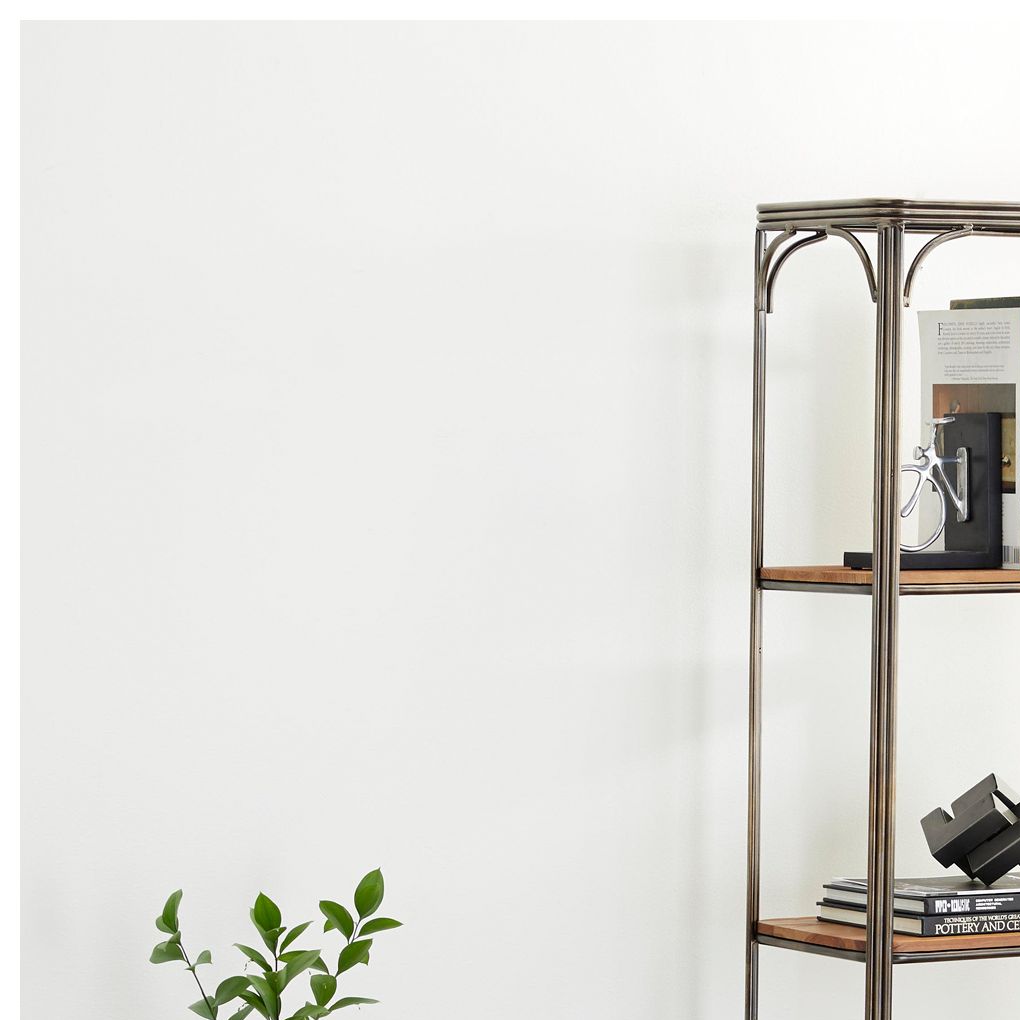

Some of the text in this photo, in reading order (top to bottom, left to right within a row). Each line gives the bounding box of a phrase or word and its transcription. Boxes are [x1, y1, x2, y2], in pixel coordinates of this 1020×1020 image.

[943, 916, 972, 924] TECHNIQUES
[935, 922, 980, 935] POTTERY
[981, 920, 1005, 933] AND
